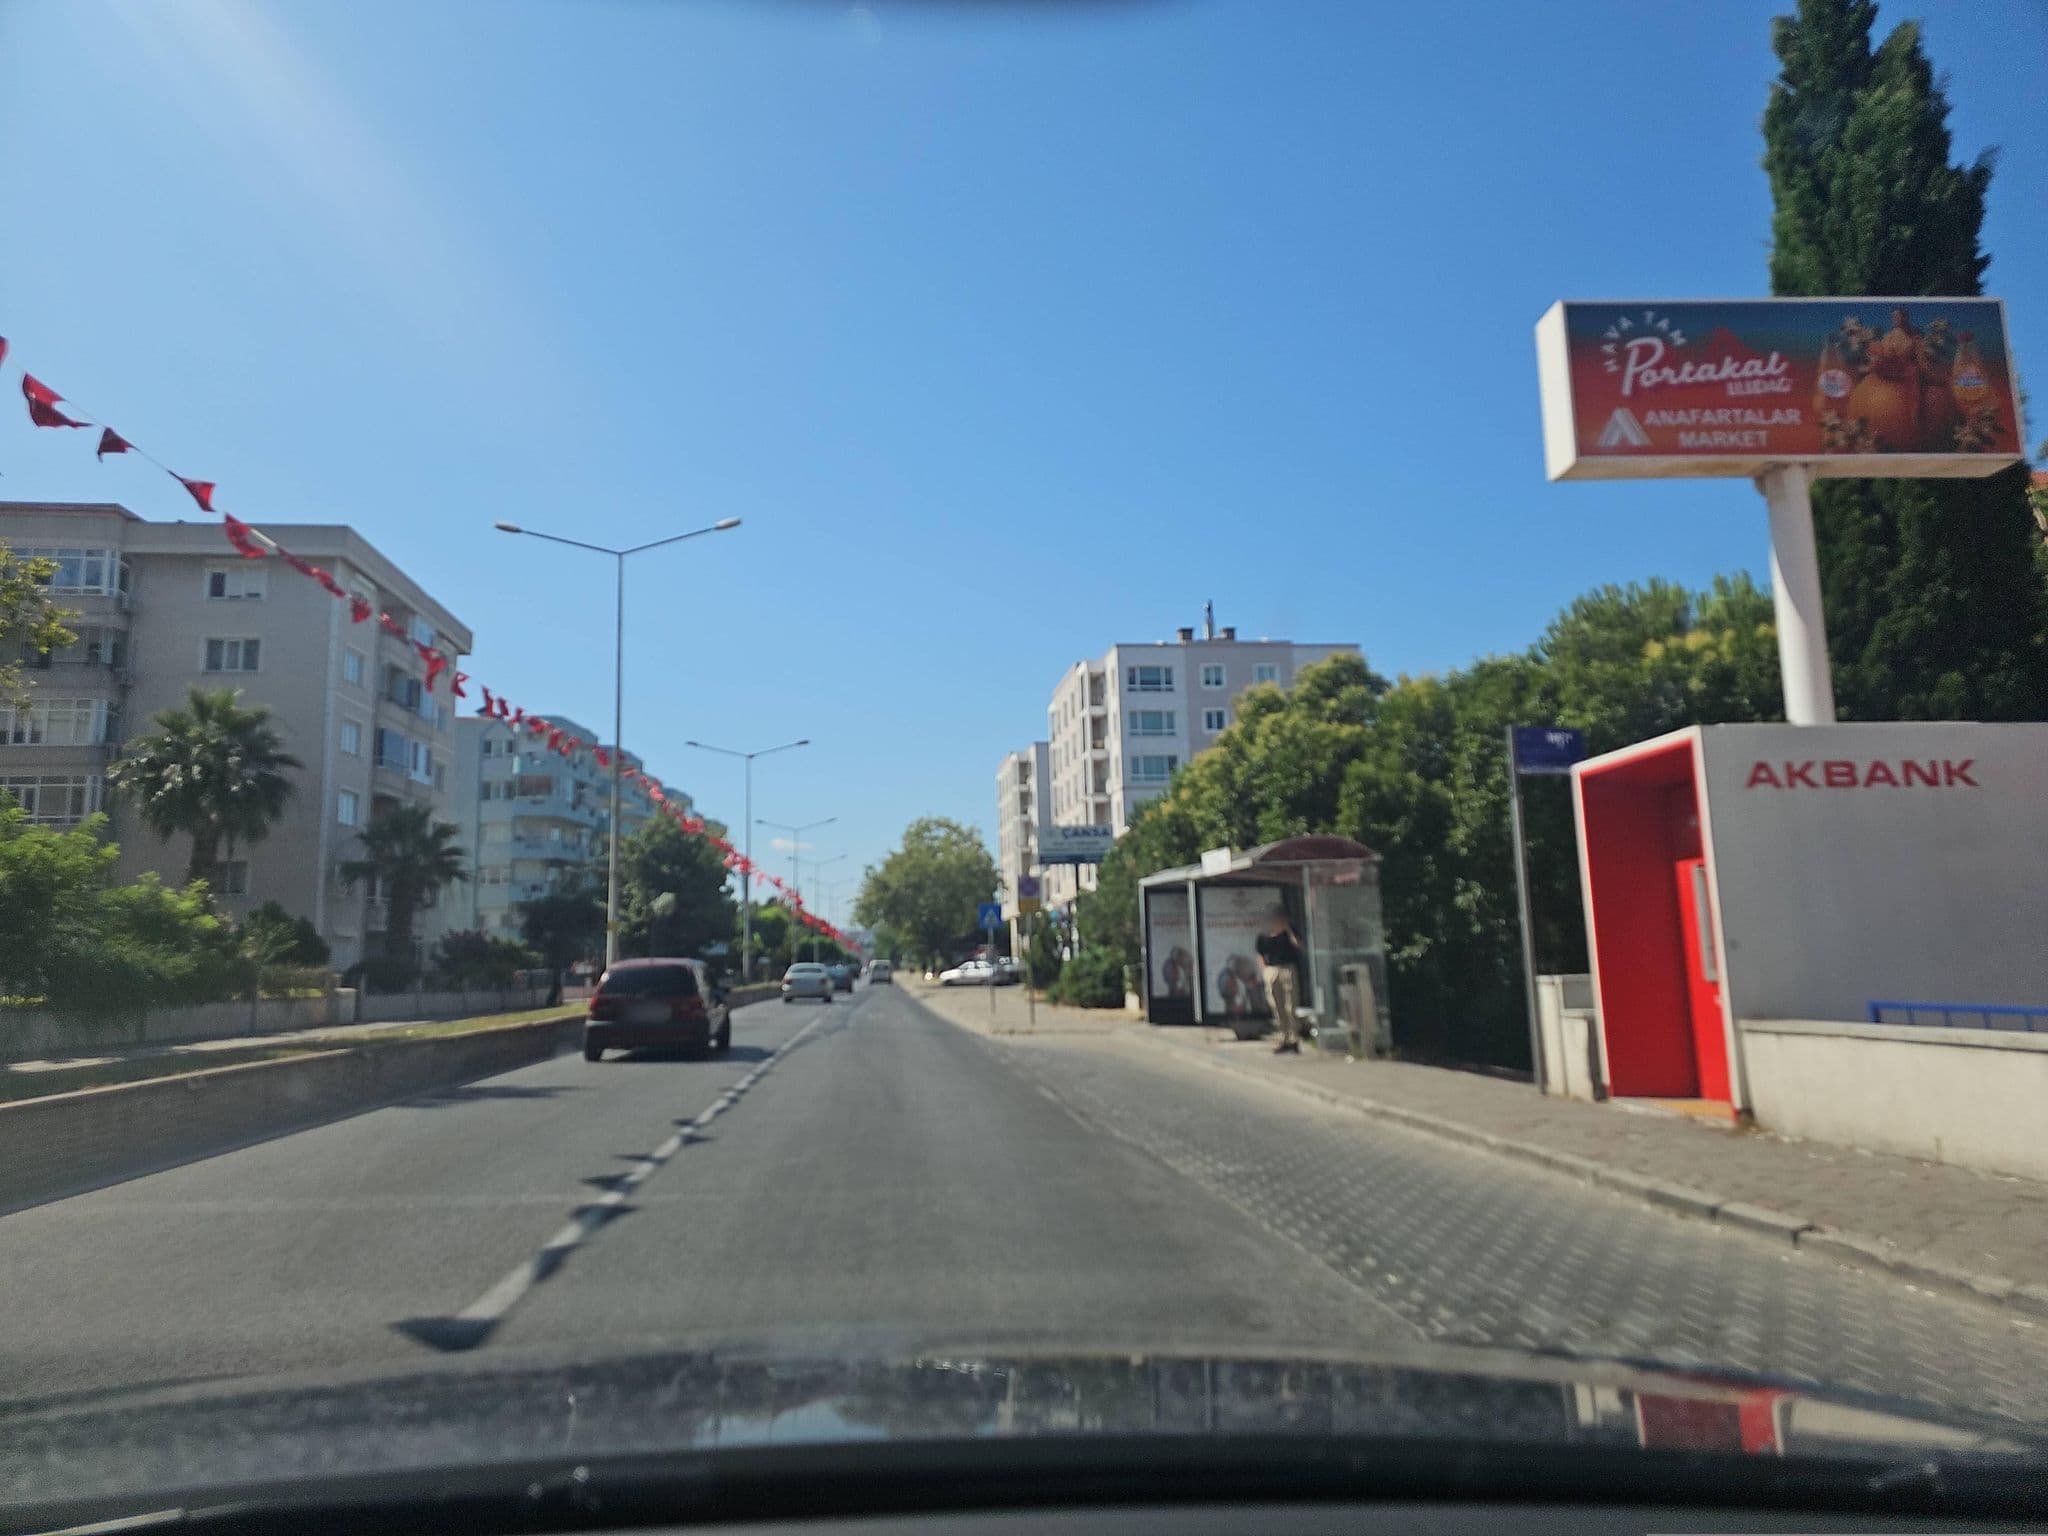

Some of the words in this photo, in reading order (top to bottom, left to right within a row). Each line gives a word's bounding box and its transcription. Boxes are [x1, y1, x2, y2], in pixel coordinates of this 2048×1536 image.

[1622, 336, 1788, 396] Portakal
[1645, 408, 1802, 426] ANAFARTALAR
[1679, 430, 1768, 447] MARKET
[1746, 759, 1980, 789] AKBANK
